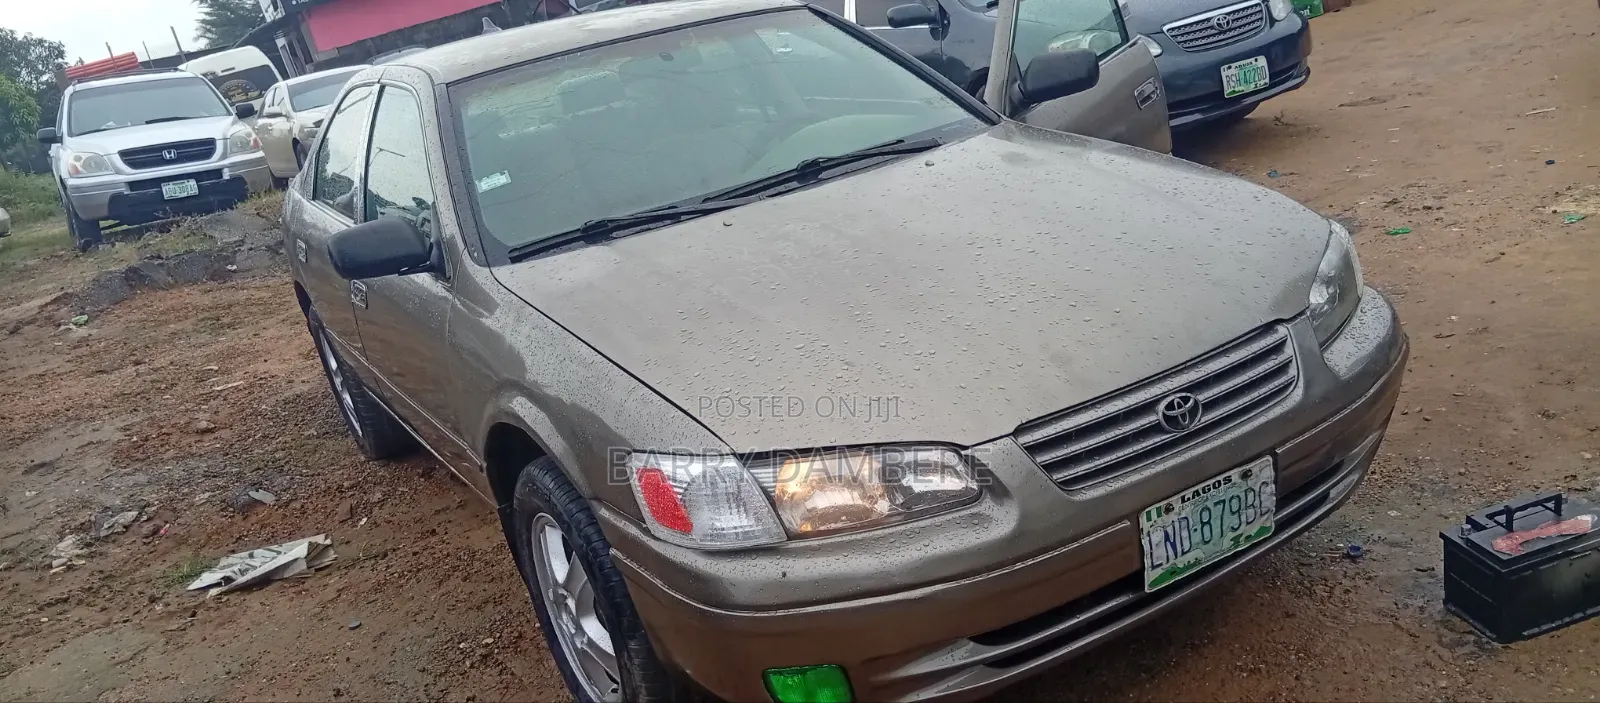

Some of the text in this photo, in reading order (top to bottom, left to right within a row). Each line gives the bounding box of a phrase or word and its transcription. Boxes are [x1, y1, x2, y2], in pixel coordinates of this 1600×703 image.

[1225, 65, 1267, 91] RSH-422BD
[1180, 475, 1233, 503] LAGOS
[1147, 481, 1271, 571] LND-879BC
